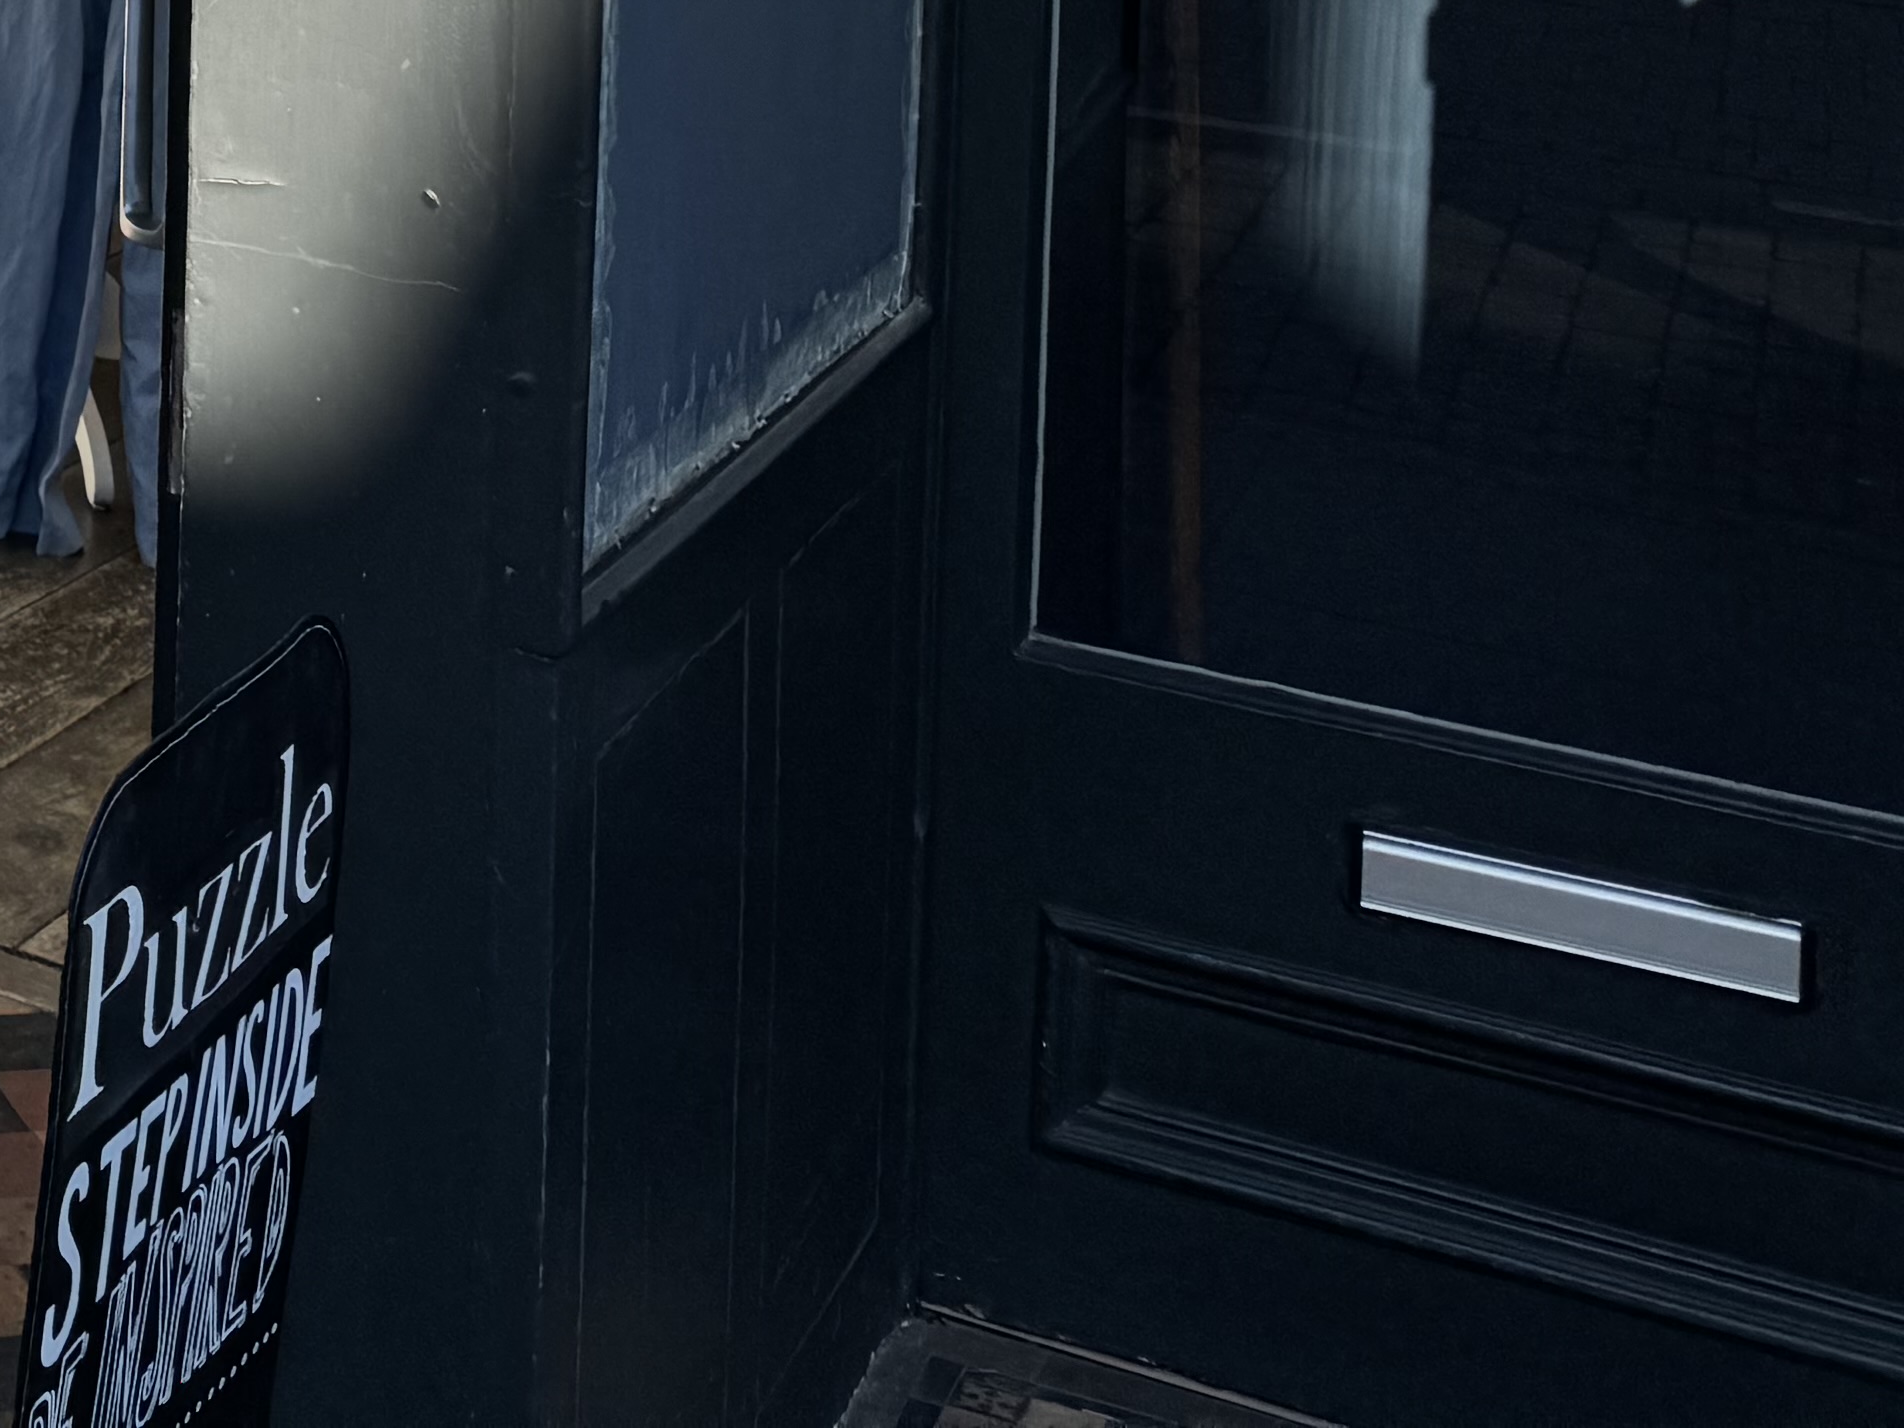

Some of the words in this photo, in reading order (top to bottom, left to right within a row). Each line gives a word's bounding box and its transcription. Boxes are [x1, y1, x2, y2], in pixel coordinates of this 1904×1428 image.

[68, 744, 332, 1123] Puzzle
[40, 1072, 187, 1368] STEP
[184, 933, 332, 1192] INSIDE
[92, 1130, 292, 1428] INSPIRED
